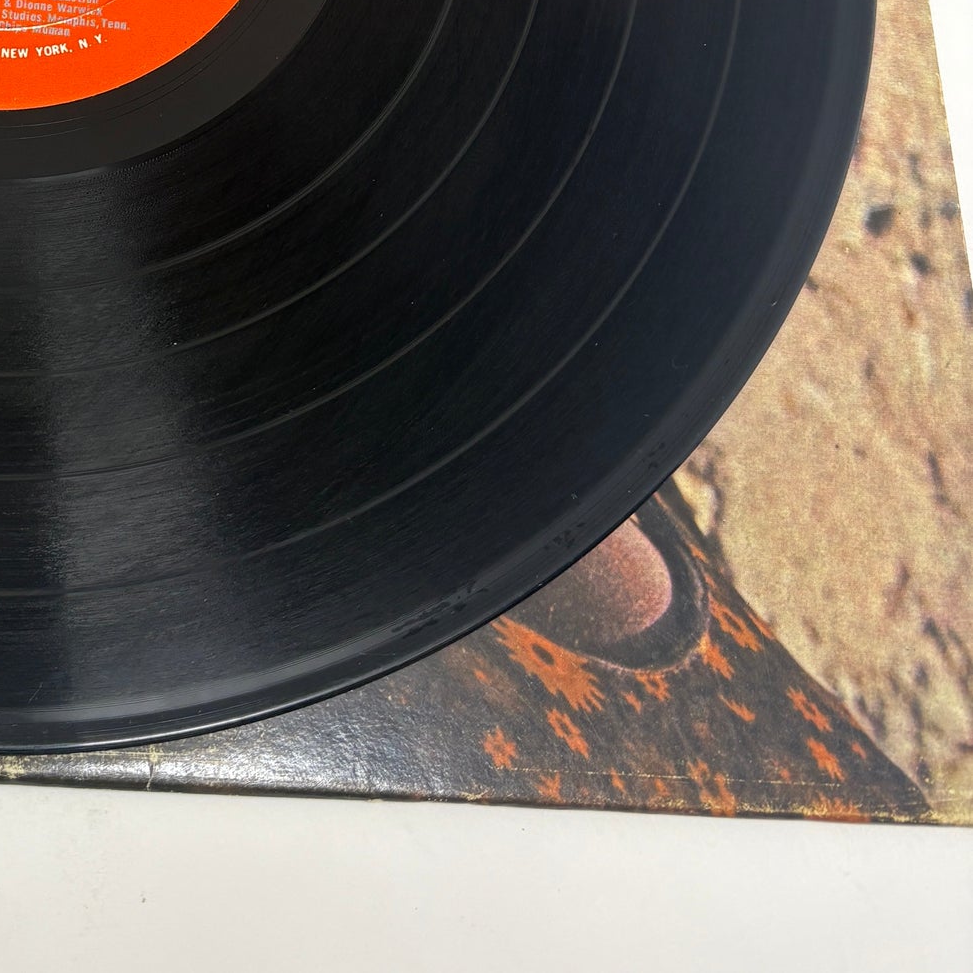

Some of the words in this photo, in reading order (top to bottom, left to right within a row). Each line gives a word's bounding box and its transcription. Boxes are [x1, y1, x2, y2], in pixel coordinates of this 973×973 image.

[15, 0, 54, 12] Dionne
[57, 2, 103, 17] Warwick
[101, 18, 131, 31] Tenn.
[0, 47, 29, 60] NEW
